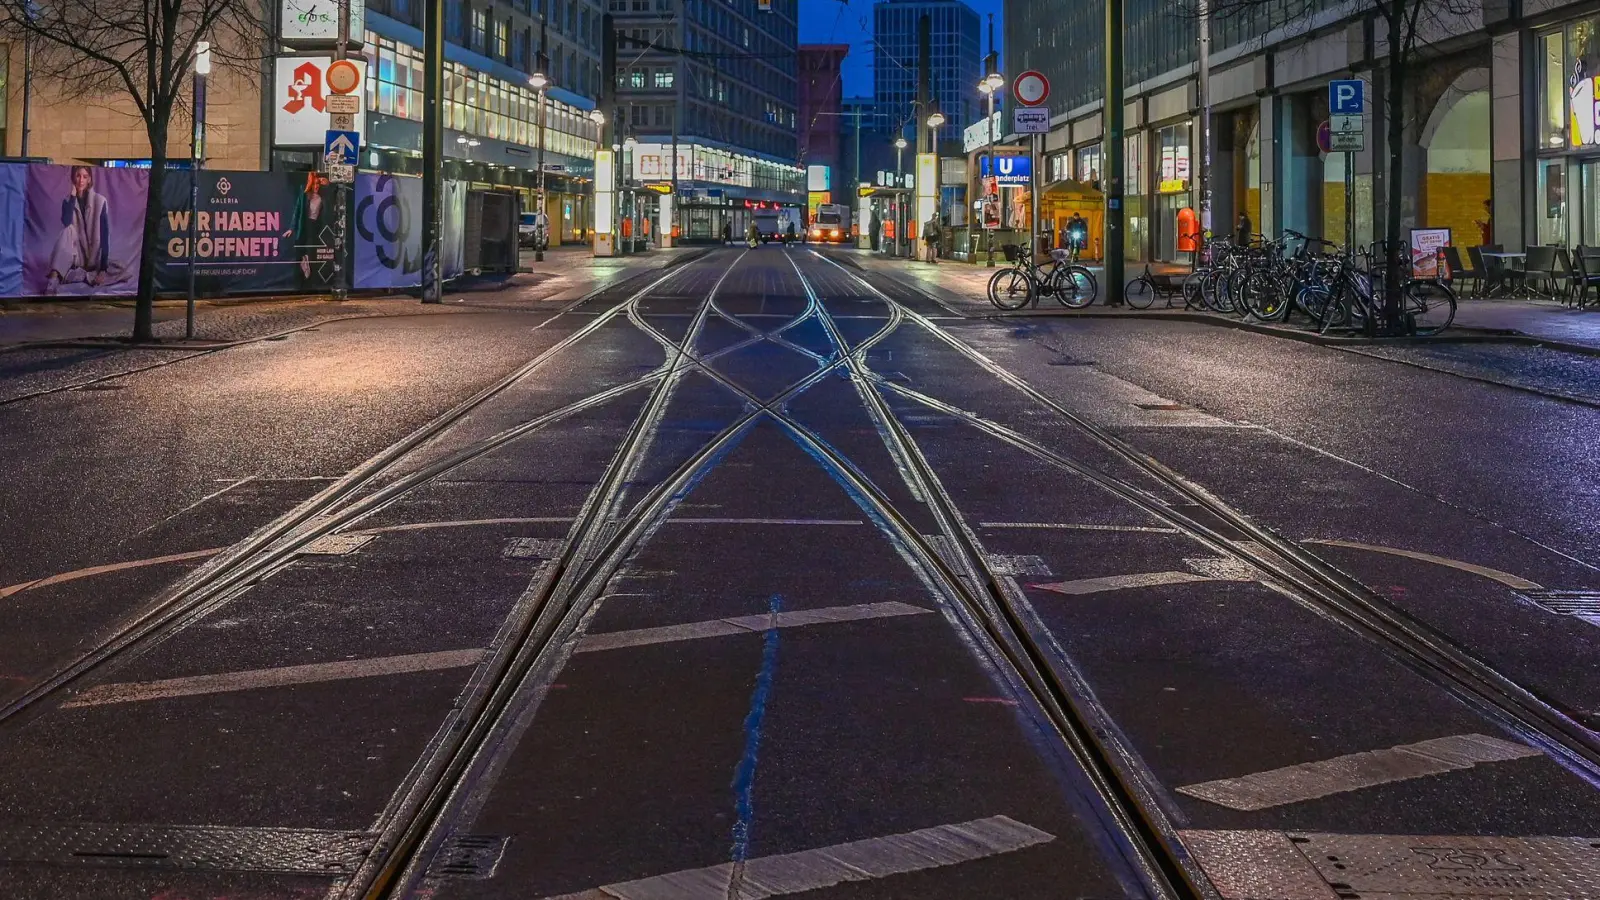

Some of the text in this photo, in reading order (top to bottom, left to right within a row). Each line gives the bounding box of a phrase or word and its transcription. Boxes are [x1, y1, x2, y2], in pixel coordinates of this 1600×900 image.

[1337, 84, 1355, 110] P
[1026, 123, 1038, 131] frei
[999, 158, 1013, 174] U
[983, 174, 1030, 183] anderplatz
[167, 210, 280, 231] WR HABEN
[232, 268, 242, 276] AUF
